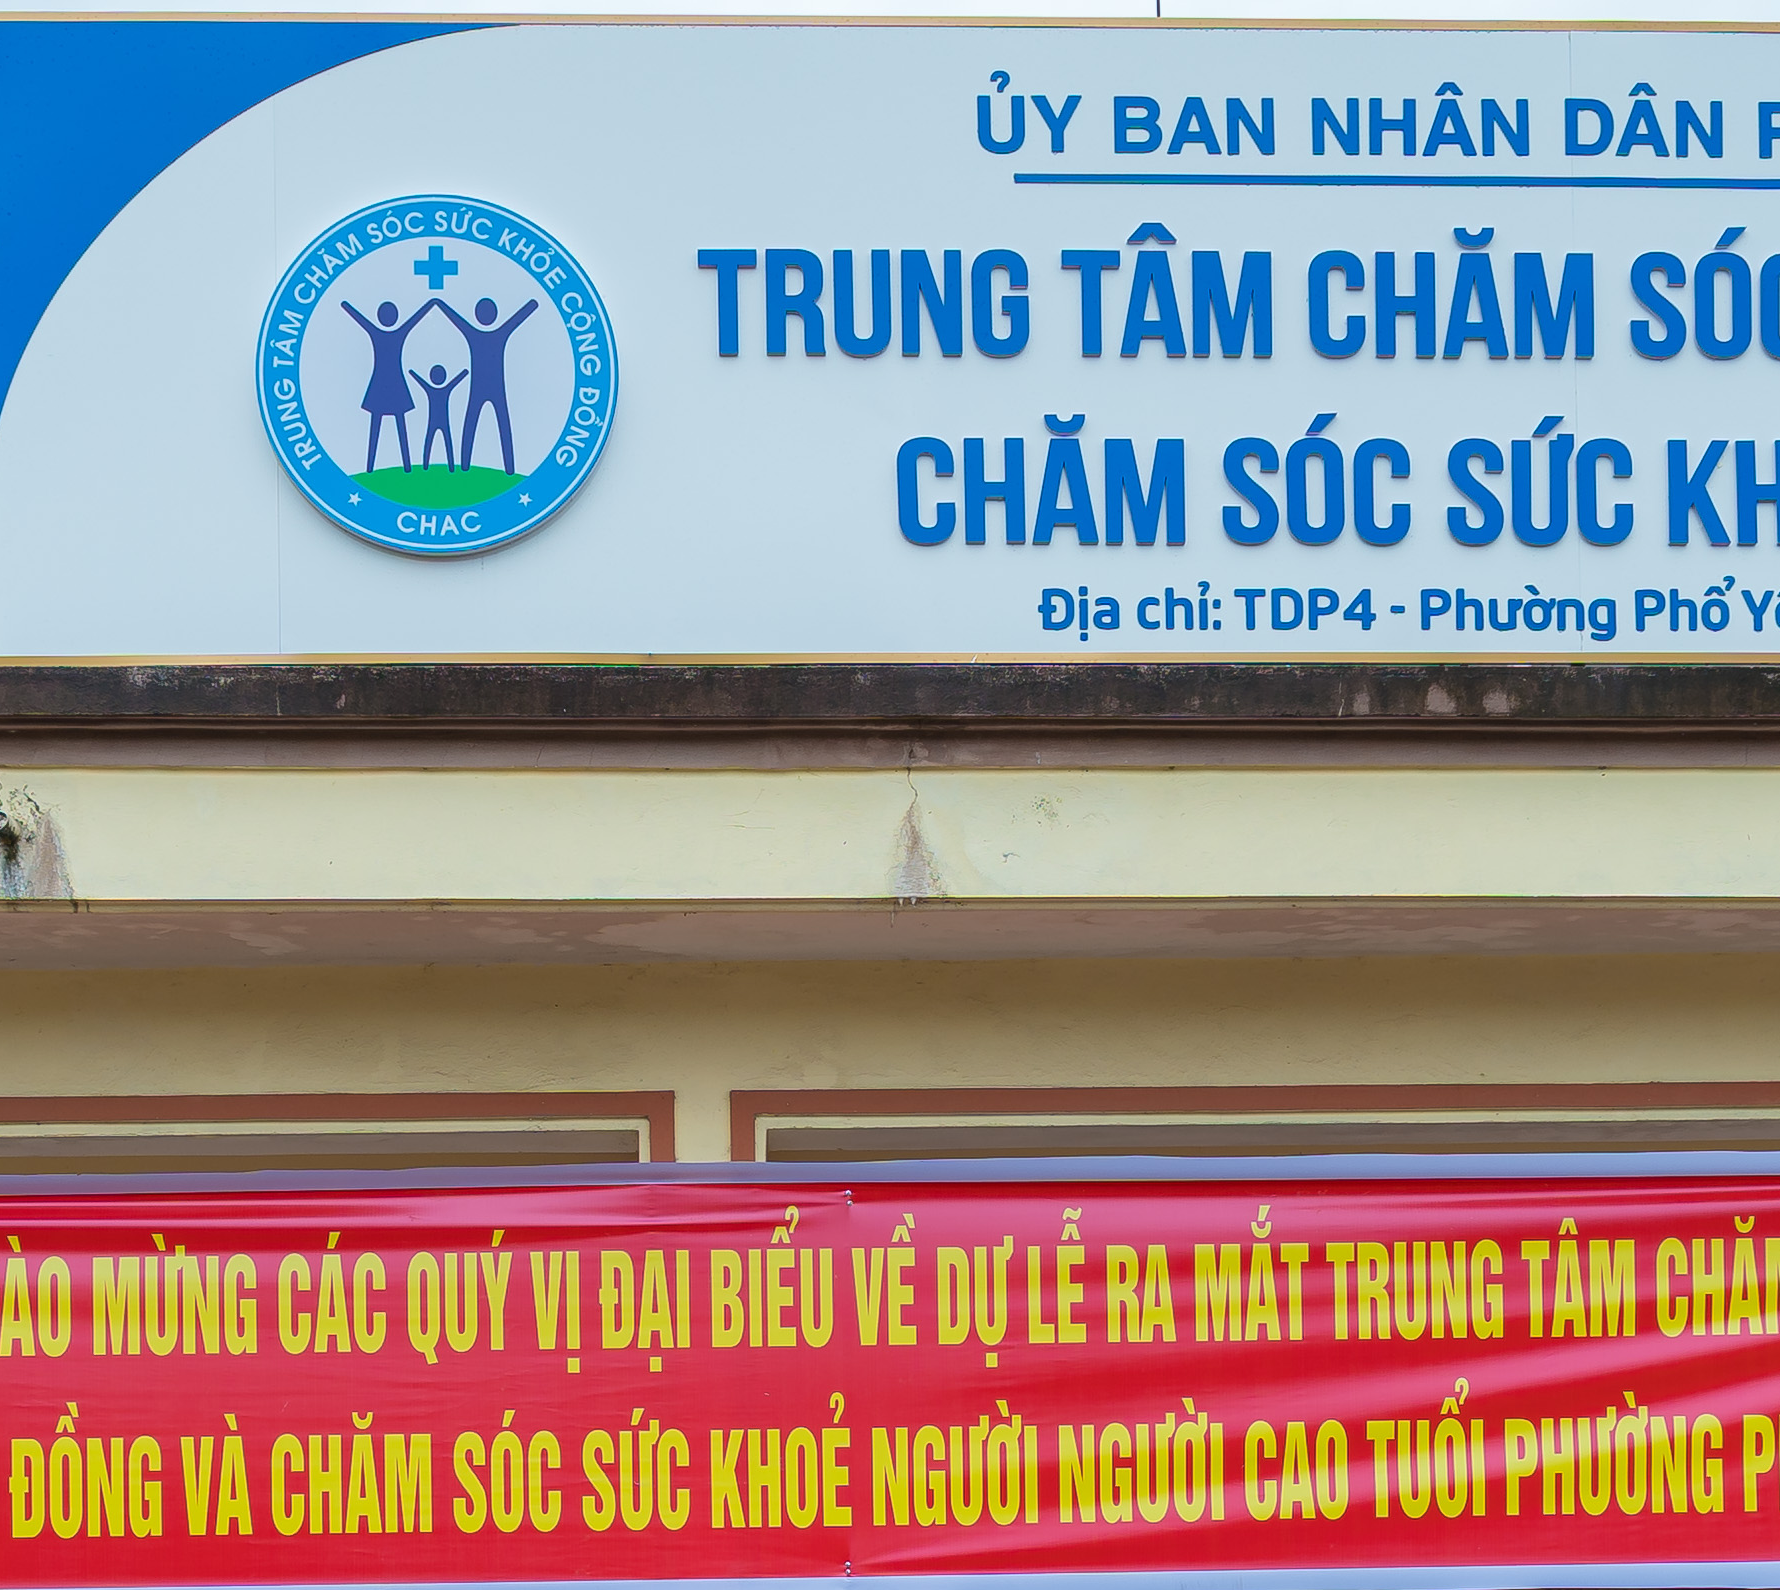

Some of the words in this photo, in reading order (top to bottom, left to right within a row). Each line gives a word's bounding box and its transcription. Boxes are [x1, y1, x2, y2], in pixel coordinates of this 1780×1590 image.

[976, 70, 1082, 155] ỦY
[1114, 96, 1276, 156] BAN
[1310, 82, 1530, 157] NHÂN
[1564, 83, 1724, 159] DÂN
[366, 210, 425, 244] SÓC
[434, 207, 493, 239] SỨC
[499, 227, 567, 291] KHỎE
[292, 233, 364, 305] CHĂM
[698, 248, 1030, 356] TRUNG
[1060, 223, 1273, 357] TÂM
[1307, 227, 1595, 360] CHĂM
[272, 310, 304, 368] TÂM
[561, 291, 602, 376] CỘNG
[274, 379, 323, 471] TRUNG
[555, 386, 603, 468] ĐỒNG
[897, 413, 1186, 544] CHĂM
[1221, 412, 1412, 546] SÓC
[1446, 415, 1634, 547] SỨC
[396, 511, 481, 535] CHAC
[1038, 585, 1121, 632] Địa
[1136, 580, 1222, 631] chỉ:
[1233, 587, 1377, 631] TDP4
[1421, 584, 1617, 642] Phường
[1634, 575, 1734, 631] Phổ
[92, 1234, 258, 1357] MỪNG
[277, 1232, 387, 1355] CÁC
[406, 1230, 513, 1366] QUÝ
[529, 1250, 581, 1374] VỊ
[598, 1249, 691, 1373] ĐẠI
[709, 1205, 834, 1349] BIỂU
[850, 1213, 918, 1347] VỀ
[937, 1235, 1015, 1369] DỰ
[1027, 1207, 1088, 1345] LỄ
[1106, 1243, 1177, 1344] RA
[1194, 1205, 1310, 1342] MẮT
[1325, 1238, 1505, 1341] TRUNG
[1520, 1218, 1637, 1338] TÂM
[9, 1402, 162, 1539] ĐỒNG
[180, 1413, 253, 1535] VÀ
[271, 1412, 432, 1536] CHĂM
[453, 1410, 561, 1533] SÓC
[582, 1408, 690, 1531] SỨC
[872, 1400, 1039, 1526] NGƯỜI
[1059, 1398, 1225, 1524] NGƯỜI
[1245, 1419, 1349, 1521] CAO
[1367, 1378, 1485, 1518] TUỔI
[1505, 1391, 1724, 1516] PHƯỜNG
